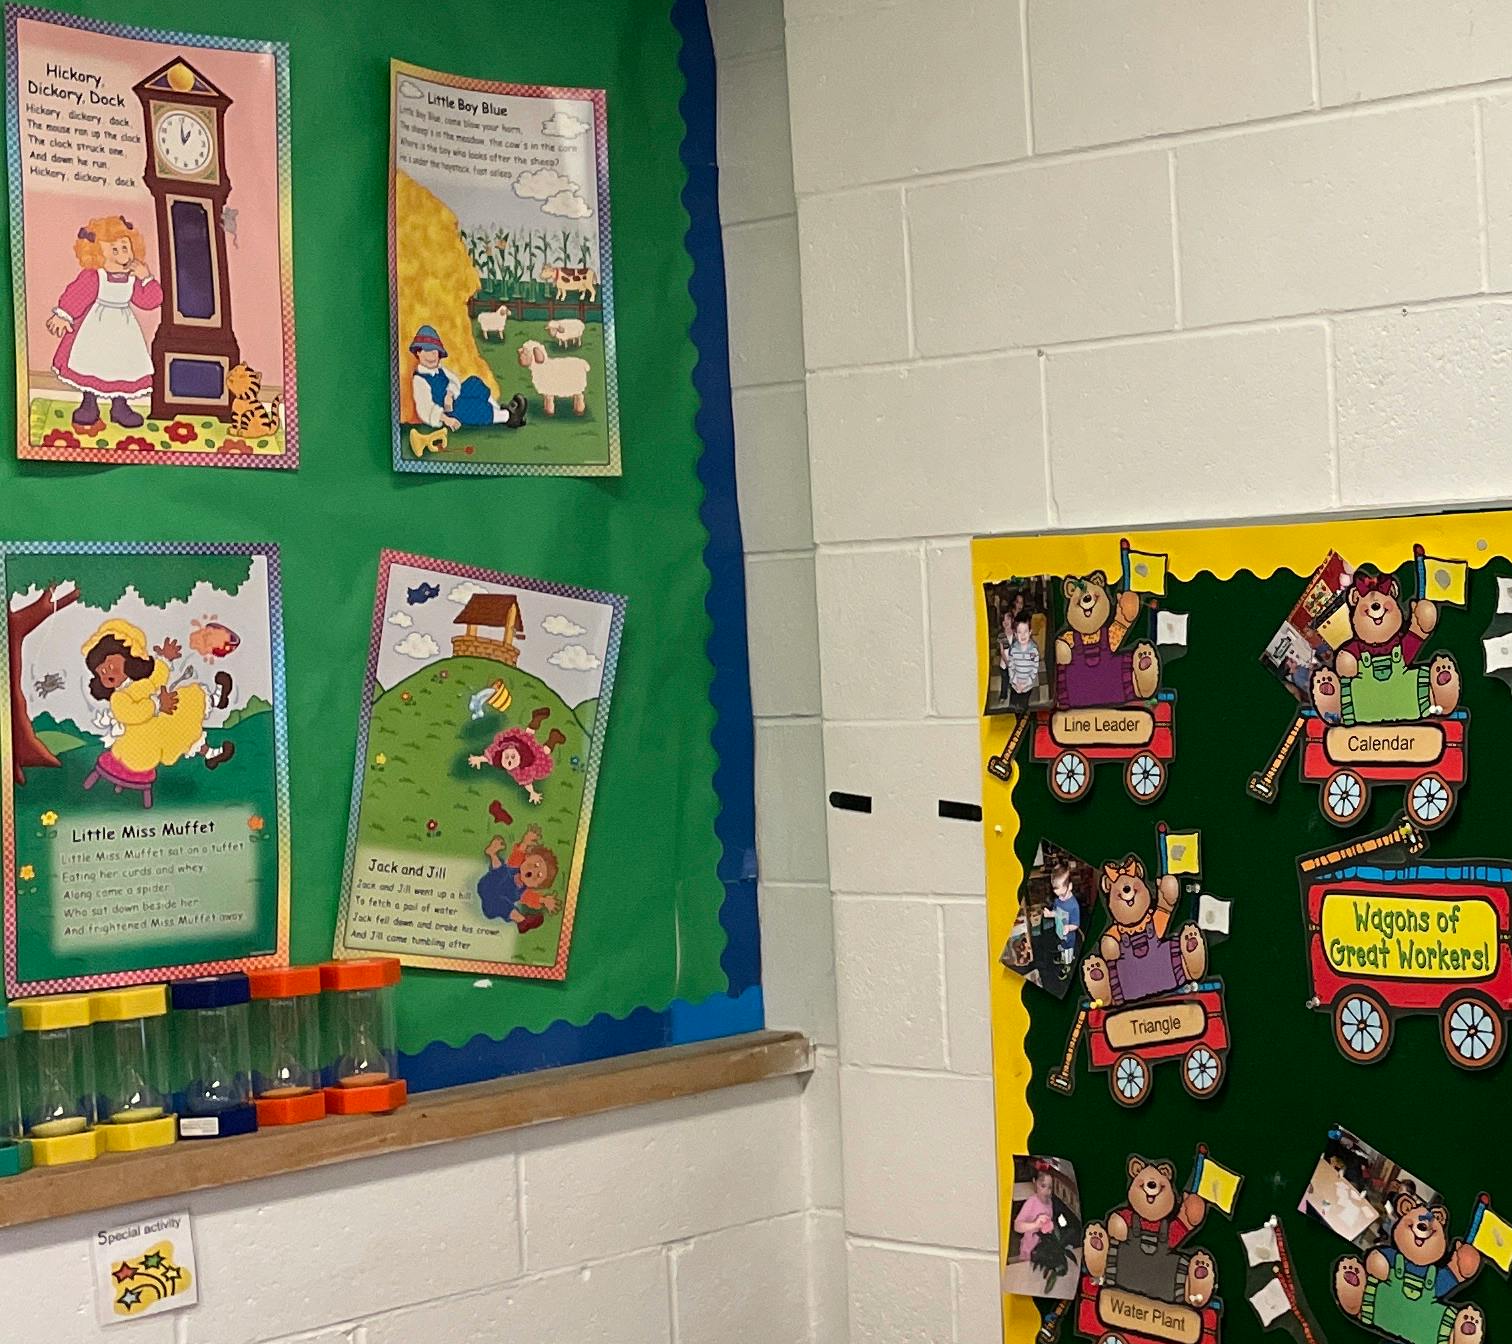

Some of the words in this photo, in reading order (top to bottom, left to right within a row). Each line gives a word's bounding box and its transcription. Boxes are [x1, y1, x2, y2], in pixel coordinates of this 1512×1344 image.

[47, 63, 105, 88] Hickory,
[28, 80, 86, 105] Dickory,
[90, 90, 125, 107] Dock
[427, 91, 455, 109] Little
[458, 98, 478, 116] Boy
[482, 101, 508, 117] Blue
[1064, 717, 1091, 732] Line
[1094, 717, 1140, 732] Leader
[1348, 734, 1415, 751] Calendar
[72, 826, 116, 843] Little
[122, 826, 156, 839] Miss
[162, 820, 215, 837] Muffet
[125, 848, 164, 860] Muffet
[368, 858, 398, 874] Jack
[401, 865, 423, 877] and
[426, 866, 447, 879] Jill
[1353, 901, 1430, 939] Wagons
[1436, 904, 1461, 934] of
[1328, 937, 1390, 969] Great
[1396, 937, 1490, 971] Workers!
[1130, 1014, 1181, 1035] Triangle
[97, 1225, 141, 1245] Special
[144, 1217, 182, 1234] activity
[1110, 1295, 1149, 1321] Water
[1152, 1308, 1186, 1332] Plant
